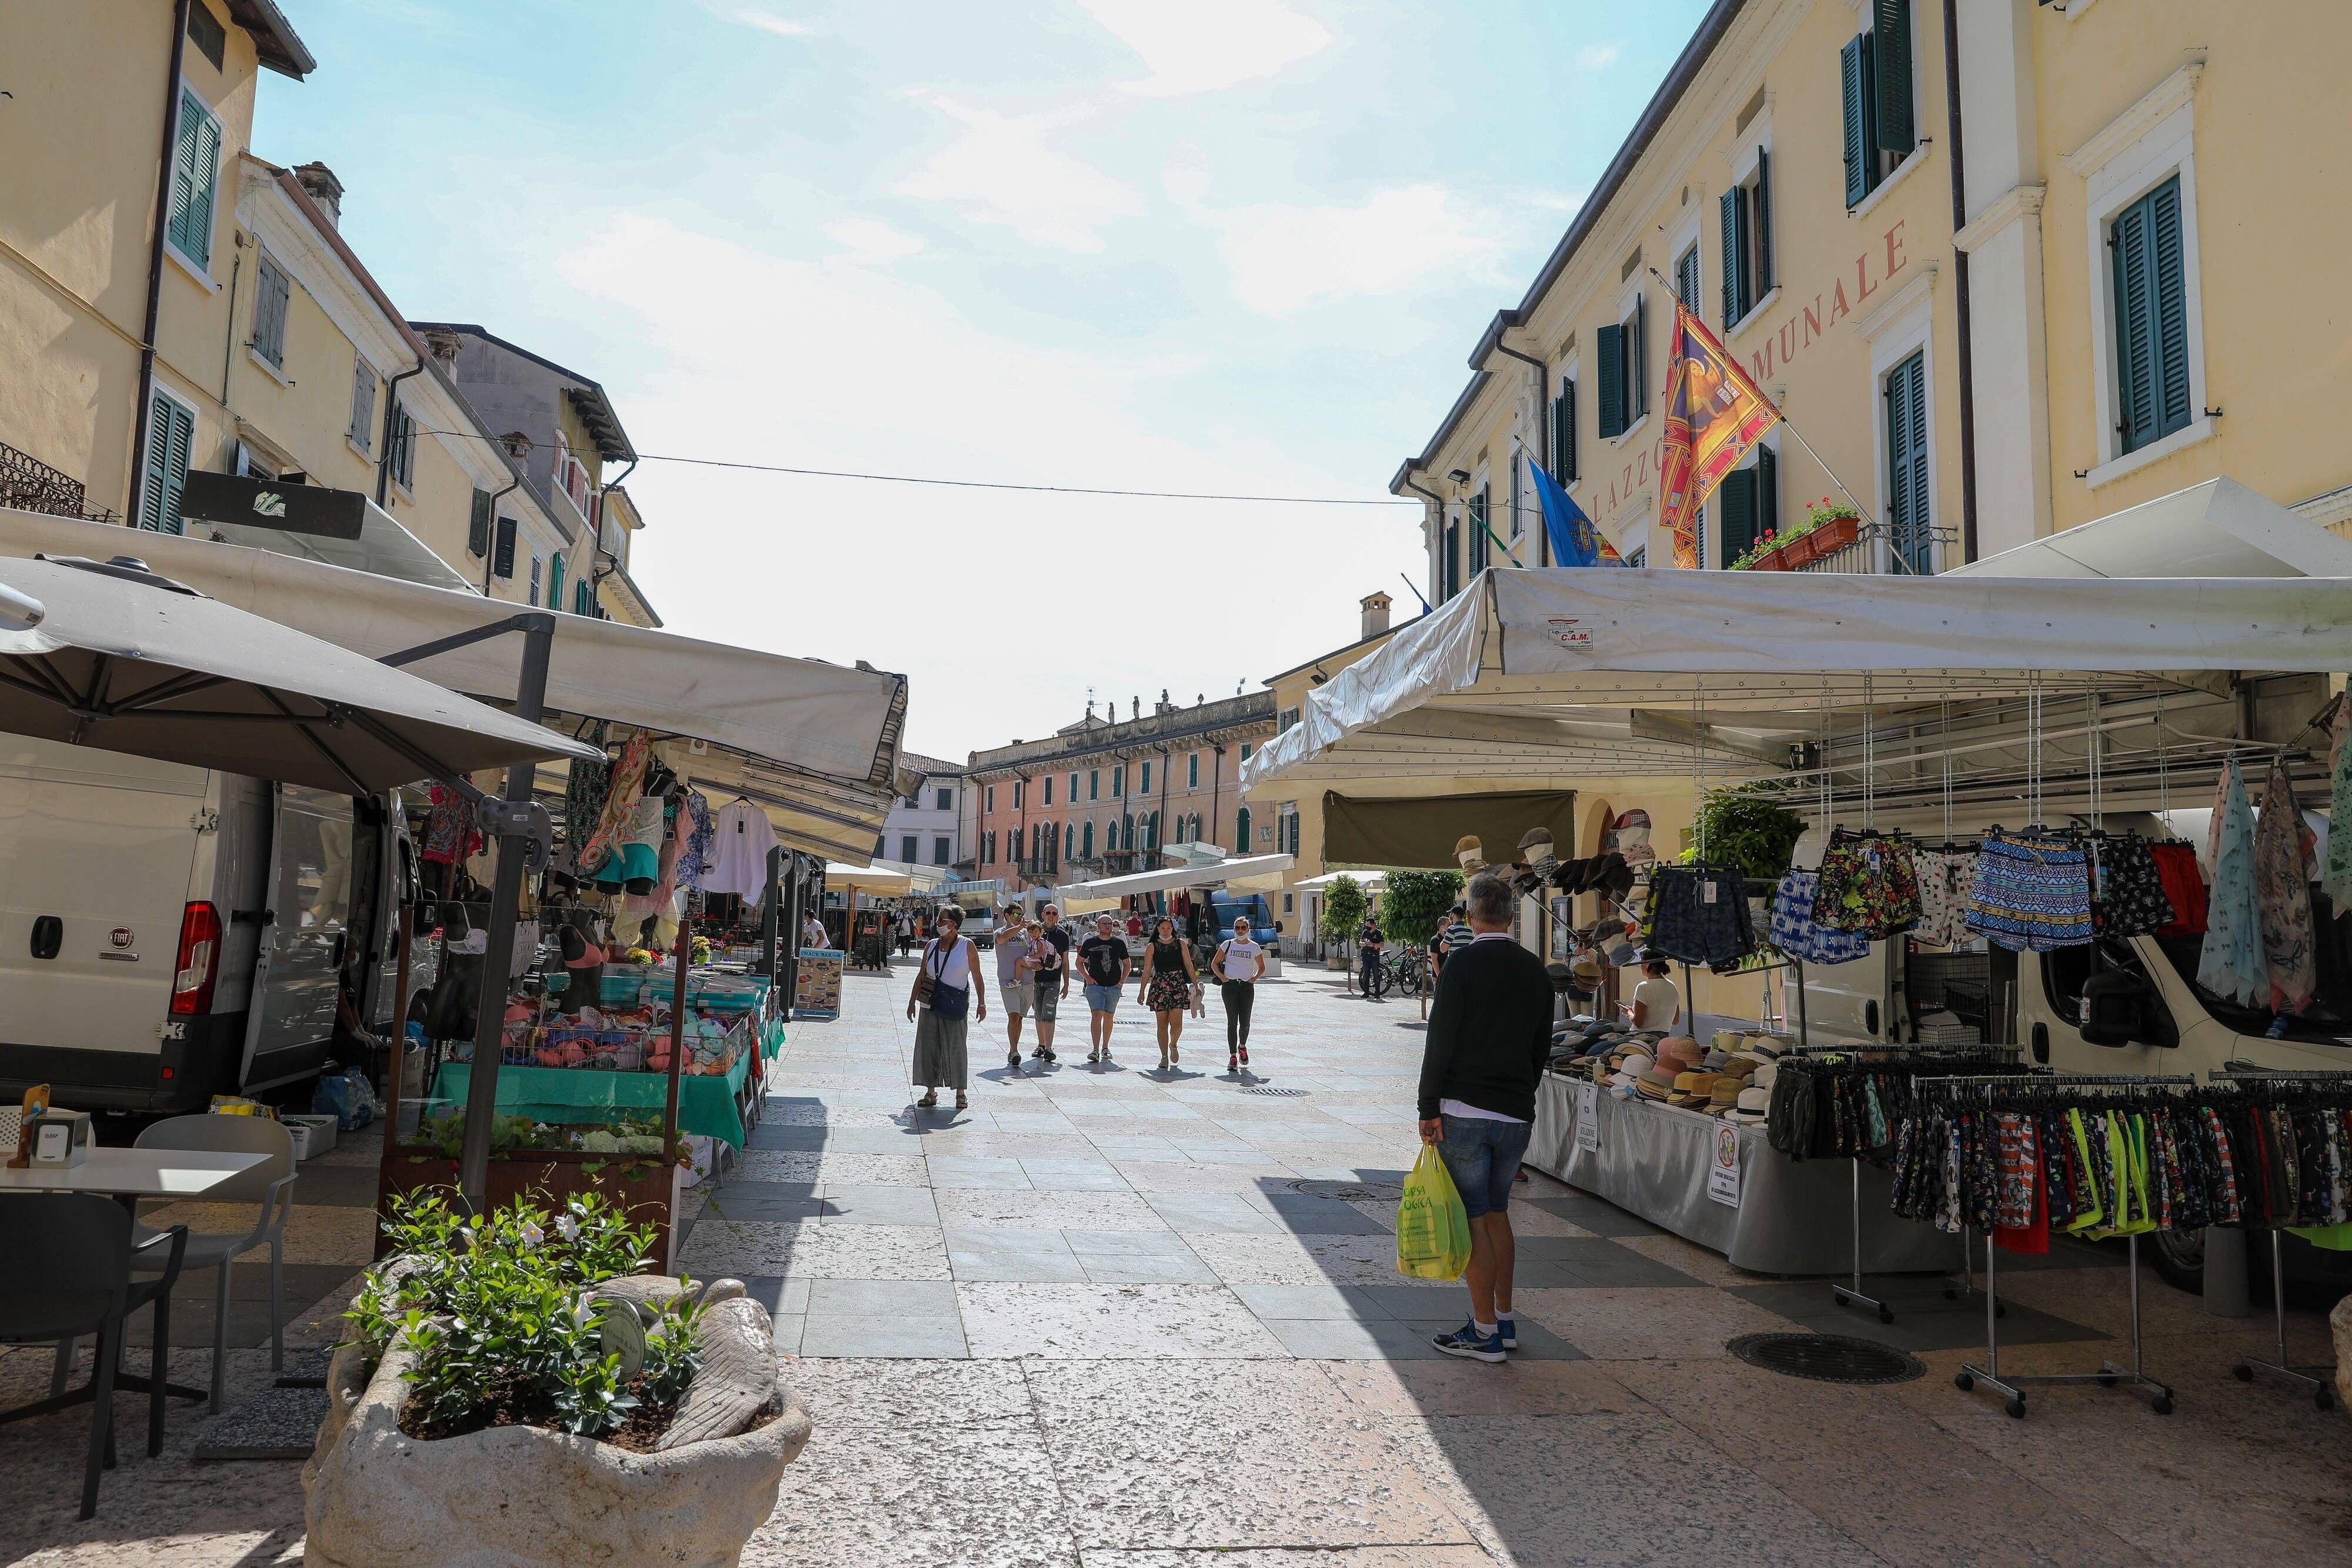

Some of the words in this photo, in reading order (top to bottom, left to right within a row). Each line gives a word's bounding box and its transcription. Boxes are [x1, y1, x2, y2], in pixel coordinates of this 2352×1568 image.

[1583, 437, 1663, 525] LAZZO
[1739, 219, 1908, 383] MUNALE
[114, 933, 128, 943] FIAT
[1403, 1185, 1425, 1197] ORSA
[1404, 1196, 1432, 1210] OGICA
